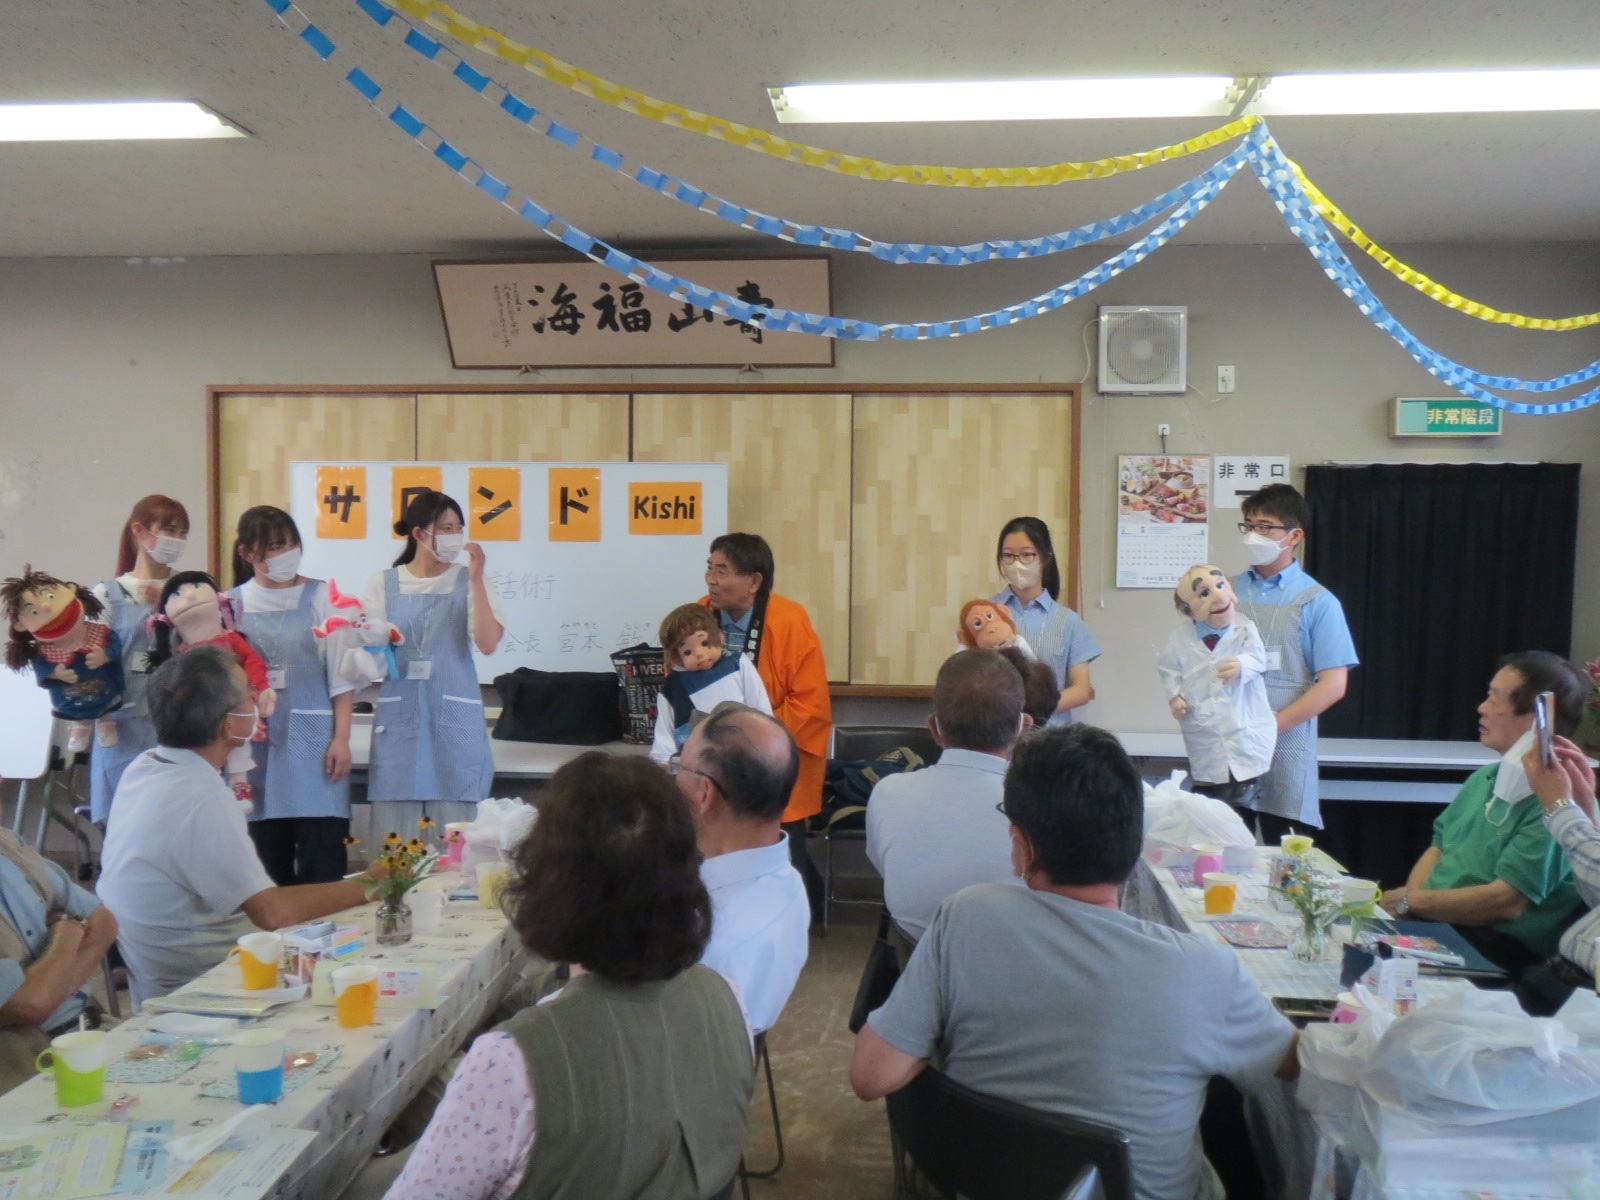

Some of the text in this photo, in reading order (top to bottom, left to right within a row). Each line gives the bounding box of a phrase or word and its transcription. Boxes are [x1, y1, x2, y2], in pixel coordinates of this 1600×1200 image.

[1426, 408, 1495, 425] 非常階段
[1218, 461, 1284, 479] 非常口
[633, 494, 696, 520] Kishi
